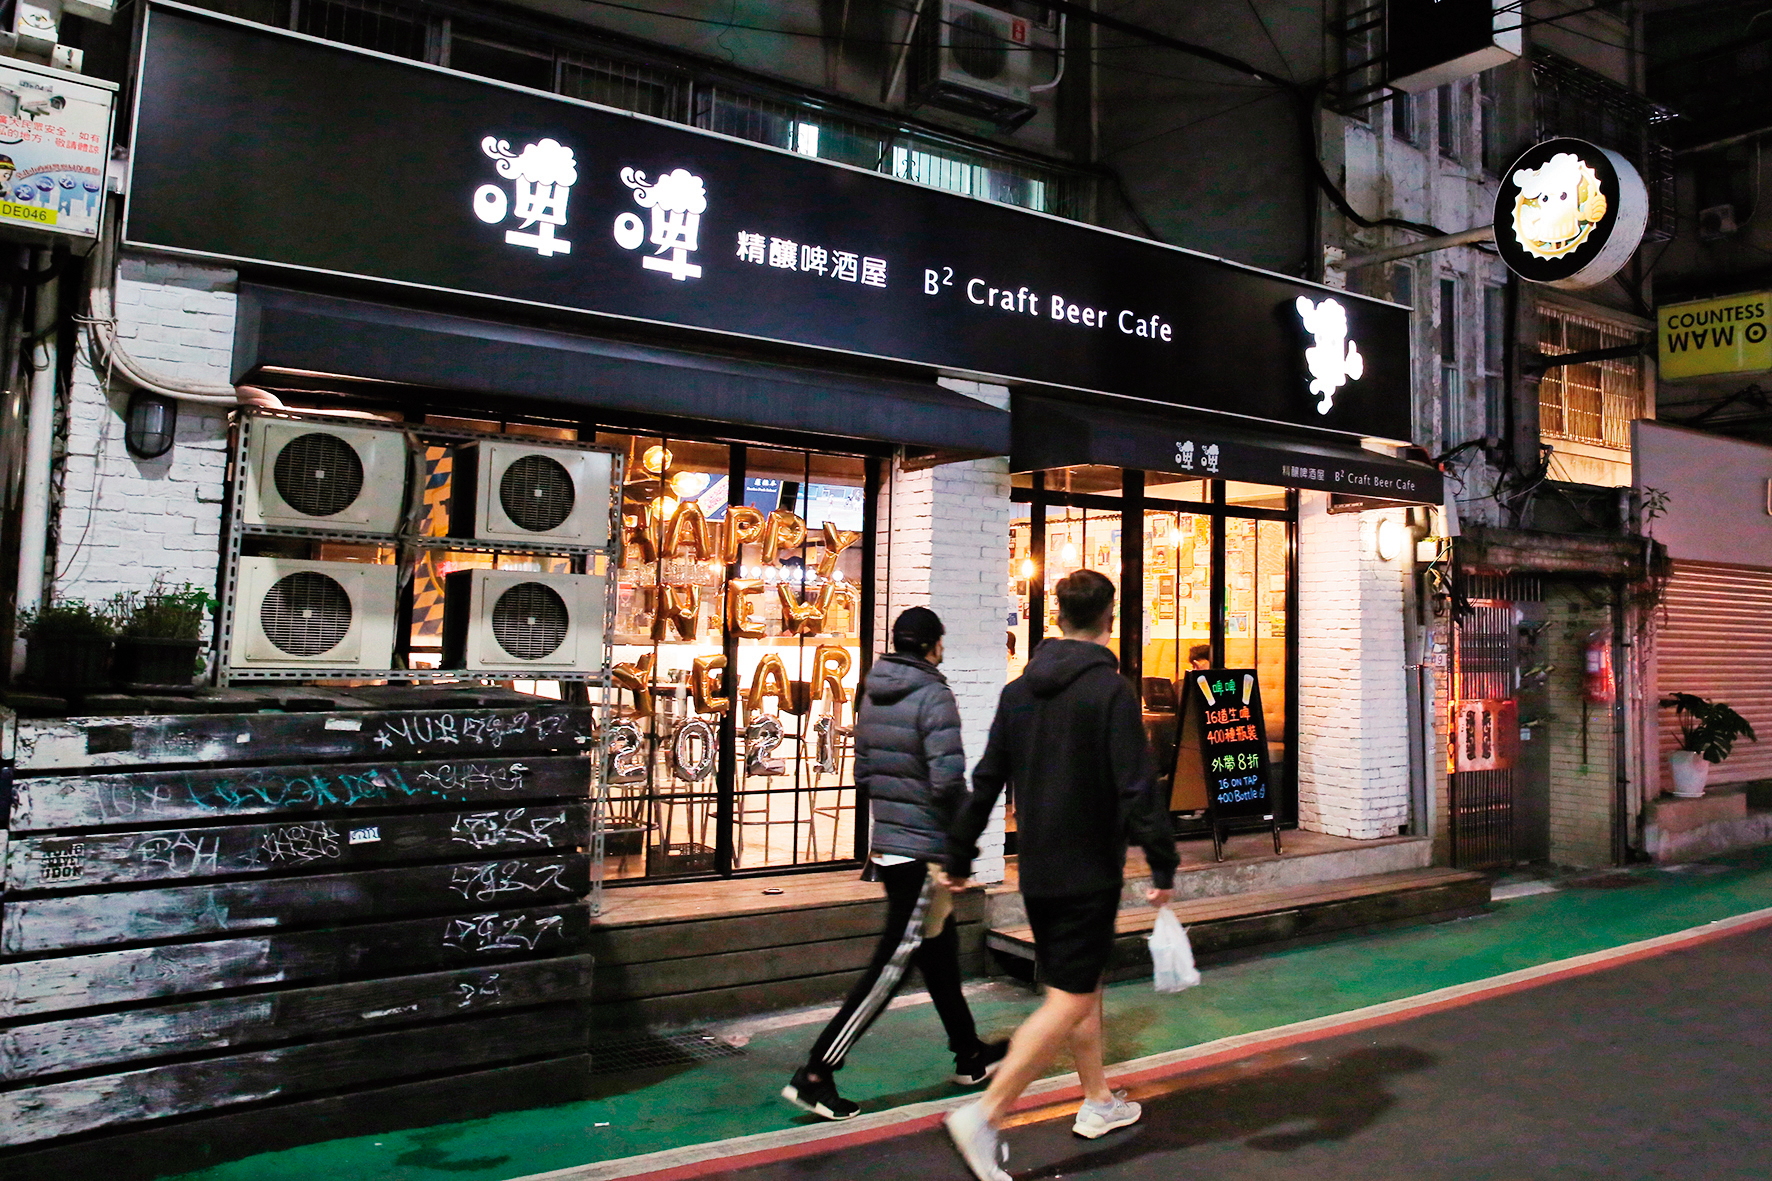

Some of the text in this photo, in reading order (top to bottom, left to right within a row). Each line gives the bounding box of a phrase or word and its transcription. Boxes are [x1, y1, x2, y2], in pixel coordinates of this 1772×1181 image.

[2, 204, 47, 221] DE046
[736, 230, 887, 288] 精釀啤酒屋
[966, 277, 1039, 316] Craft
[1050, 294, 1108, 329] Beer
[1118, 309, 1172, 342] Cafe
[1668, 303, 1764, 329] COUNTESS
[1347, 472, 1371, 486] Craft
[1373, 476, 1393, 488] Beer
[1395, 478, 1416, 492] Cafe
[651, 578, 836, 643] NEW
[612, 644, 853, 718] YEAR
[1205, 706, 1251, 725] 16道生啤
[1207, 724, 1258, 745] 400種瓶裝
[606, 712, 838, 785] 2021
[1218, 774, 1258, 790] 16 ON TAP
